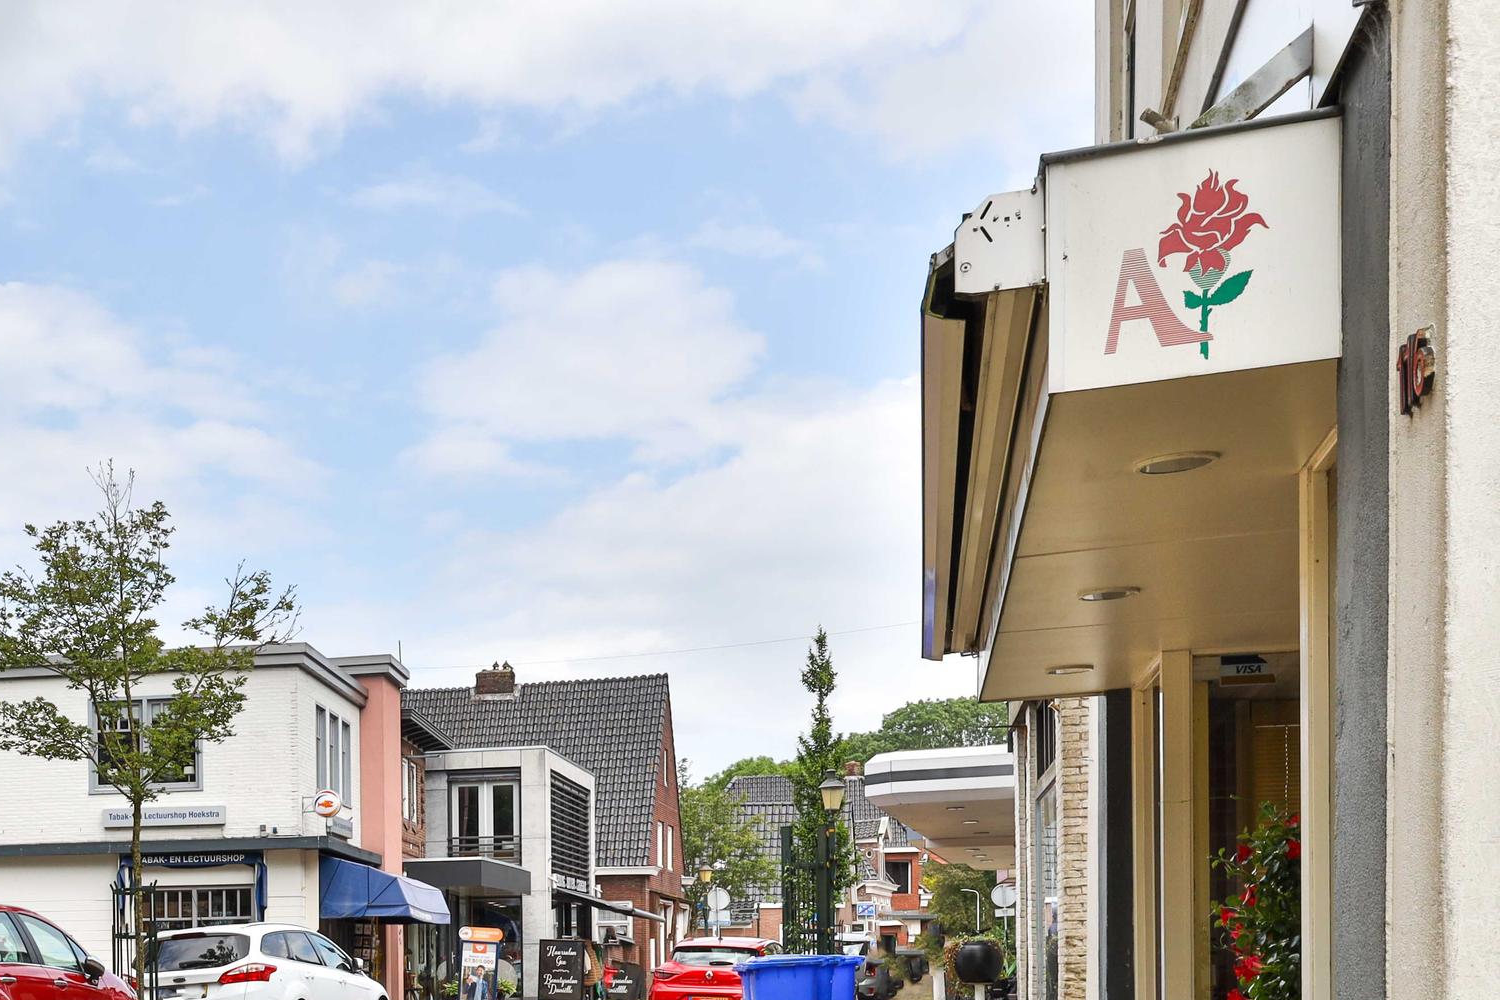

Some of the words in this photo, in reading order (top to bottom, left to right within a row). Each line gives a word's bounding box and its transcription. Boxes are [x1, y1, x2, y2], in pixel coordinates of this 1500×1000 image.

[1104, 248, 1214, 355] A
[1236, 665, 1261, 673] VISA
[144, 812, 187, 821] Lectuurshop
[141, 855, 168, 864] ABAK-
[169, 855, 181, 863] EN
[183, 854, 245, 863] LECTUURSHOP
